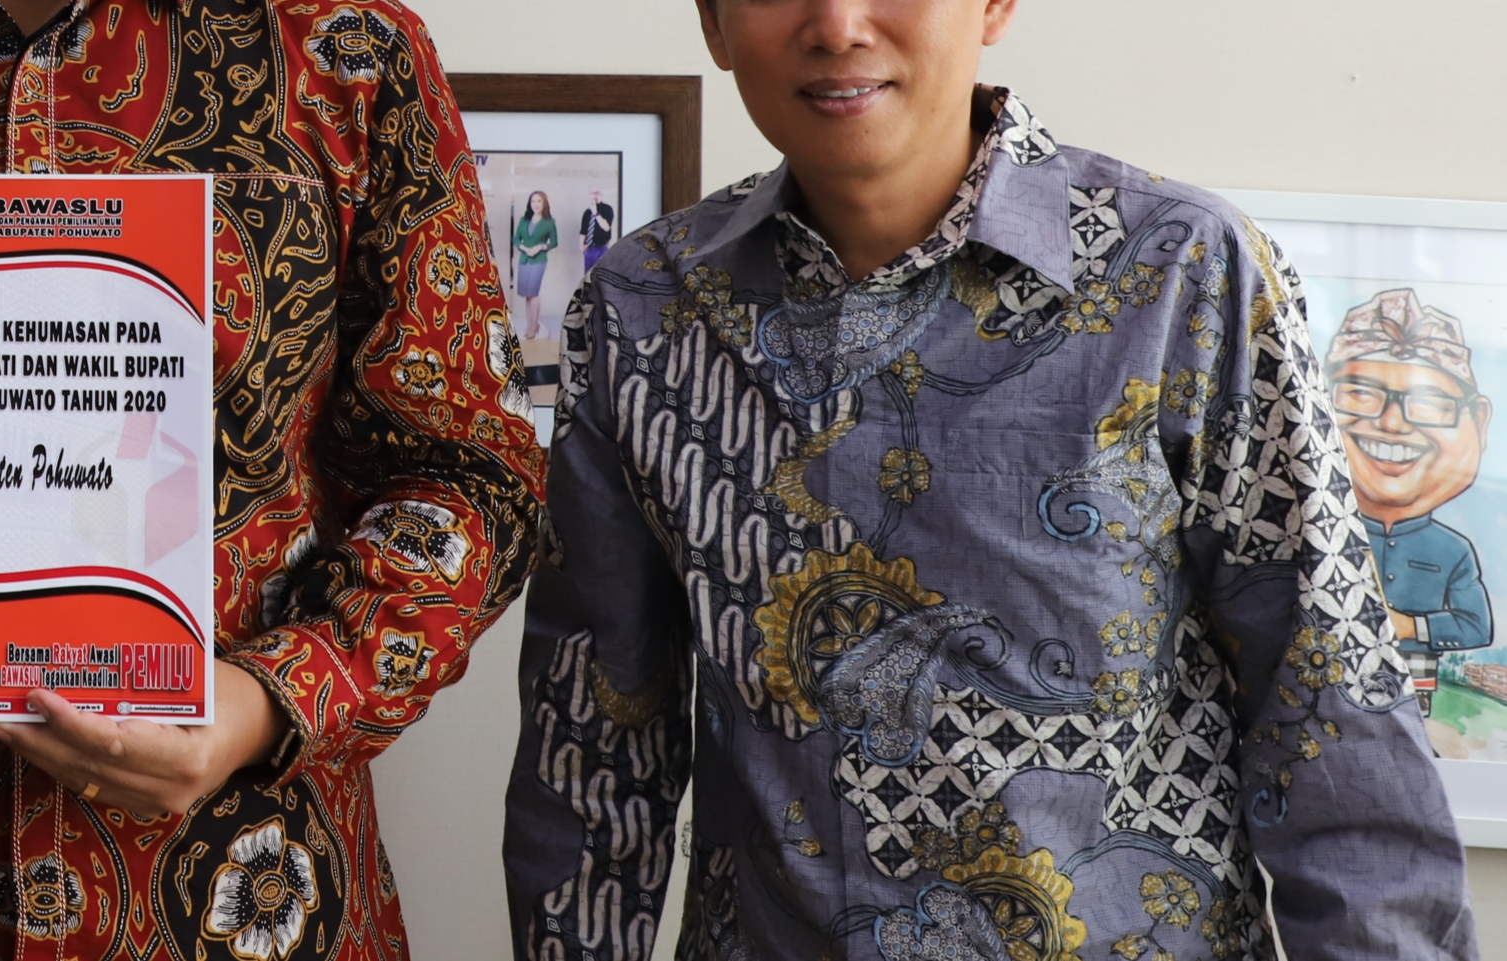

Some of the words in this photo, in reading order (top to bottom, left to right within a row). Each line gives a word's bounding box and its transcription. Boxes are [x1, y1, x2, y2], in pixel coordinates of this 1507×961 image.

[475, 155, 488, 166] TV
[15, 217, 56, 226] PENGAWAS
[57, 217, 98, 226] PEMILIHAN
[99, 217, 122, 226] UMUM
[58, 228, 122, 238] POHUWATO
[3, 321, 110, 343] KEHUMASAN
[116, 322, 161, 343] PADA
[23, 355, 58, 377] DAN
[64, 355, 119, 378] WAKIL
[124, 356, 184, 378] BUPATI
[61, 390, 117, 411] TAHUN
[124, 390, 167, 412] 2020
[31, 443, 114, 491] Pohuwato
[7, 642, 50, 664] Bersama
[52, 643, 88, 668] Rakyat
[120, 642, 194, 690] PEMILU
[0, 666, 40, 687] BAWASLU
[41, 667, 81, 690] Tegakkan
